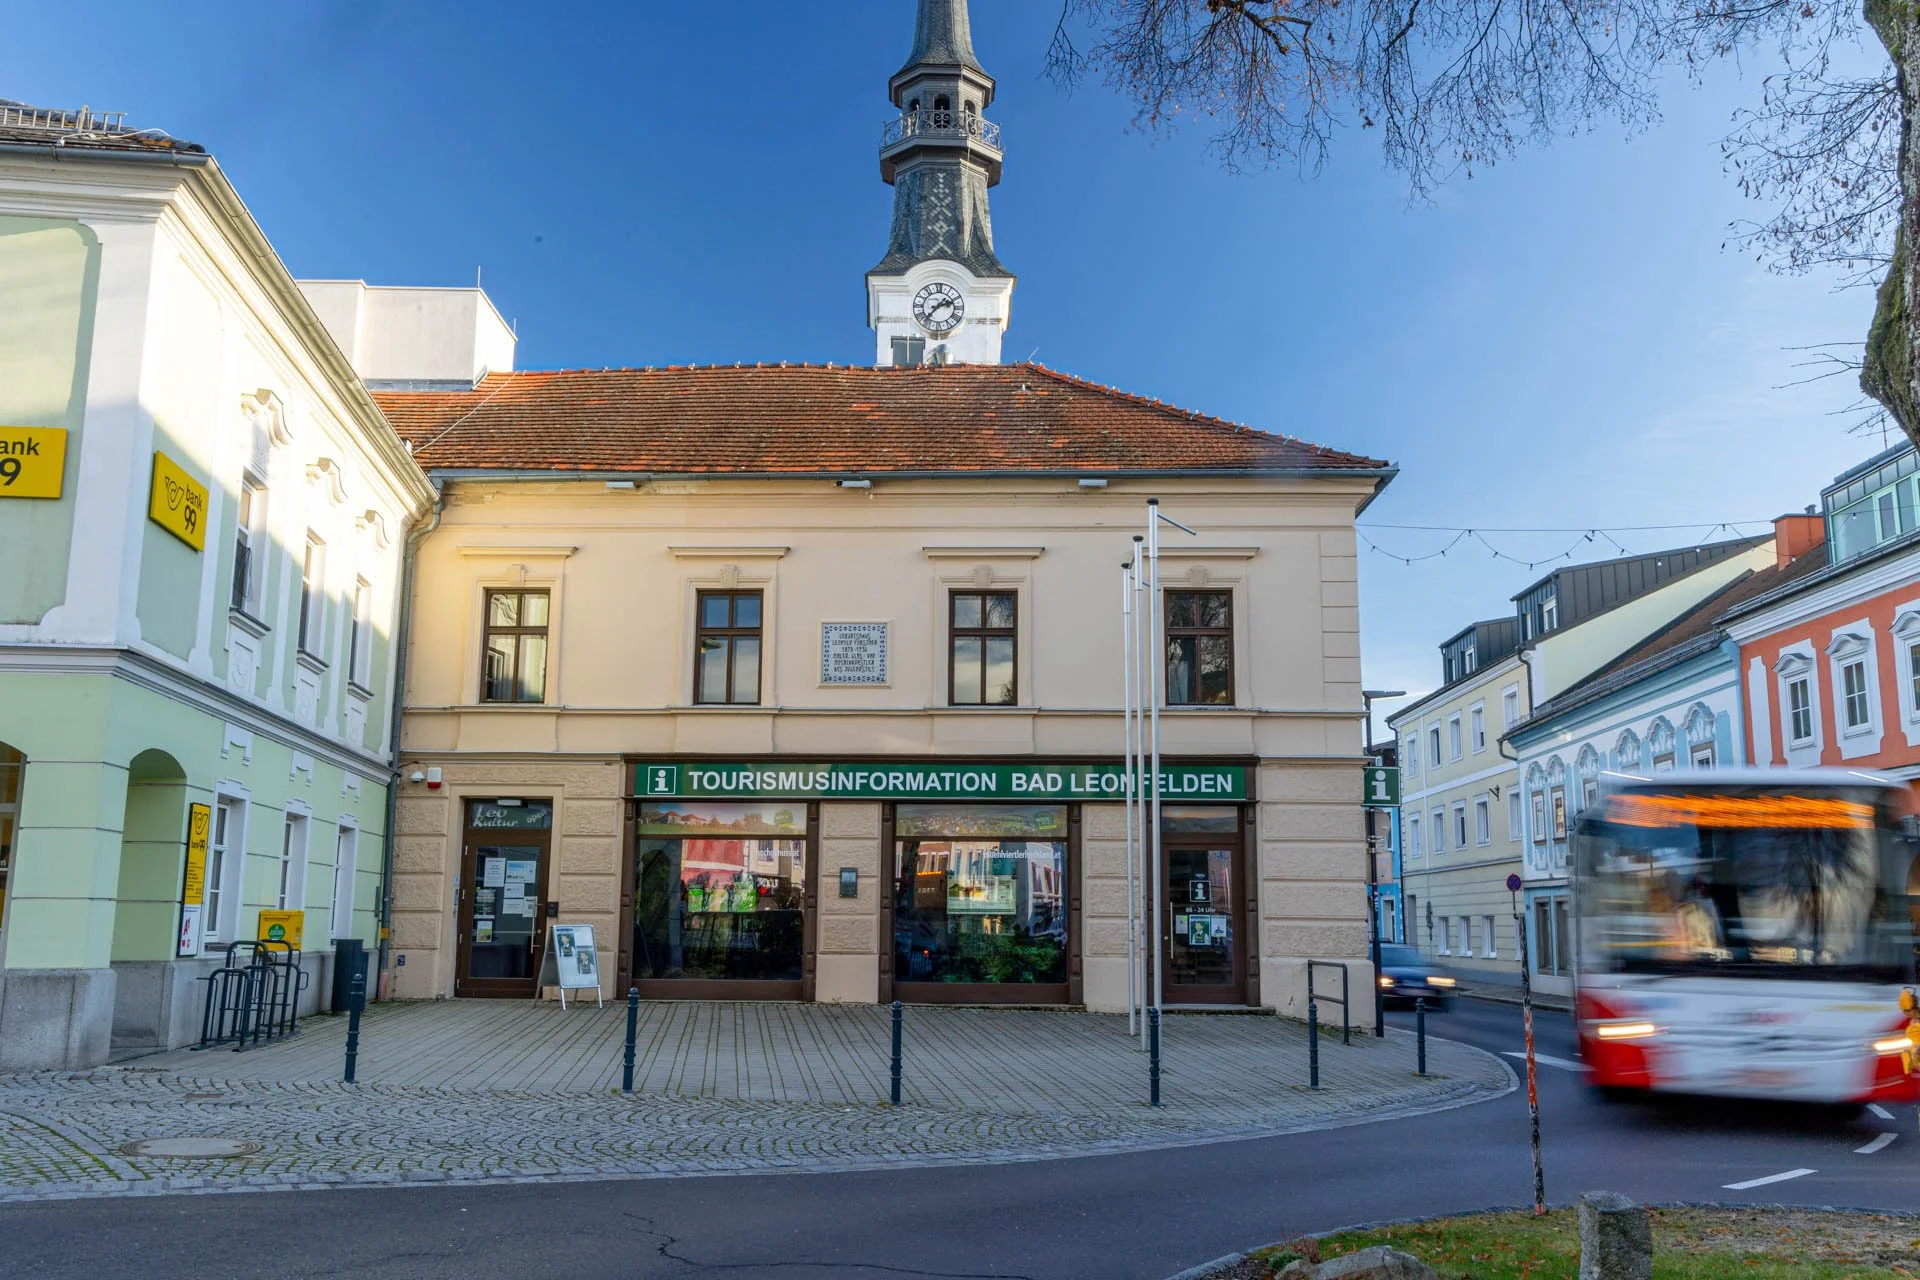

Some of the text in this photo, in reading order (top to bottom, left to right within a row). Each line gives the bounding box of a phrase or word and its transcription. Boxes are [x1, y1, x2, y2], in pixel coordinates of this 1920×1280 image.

[186, 483, 202, 511] bank
[185, 504, 197, 535] 99
[688, 771, 997, 791] TOURISMUSINFORMATION
[1012, 773, 1063, 792] BAD
[472, 817, 518, 827] Kultur
